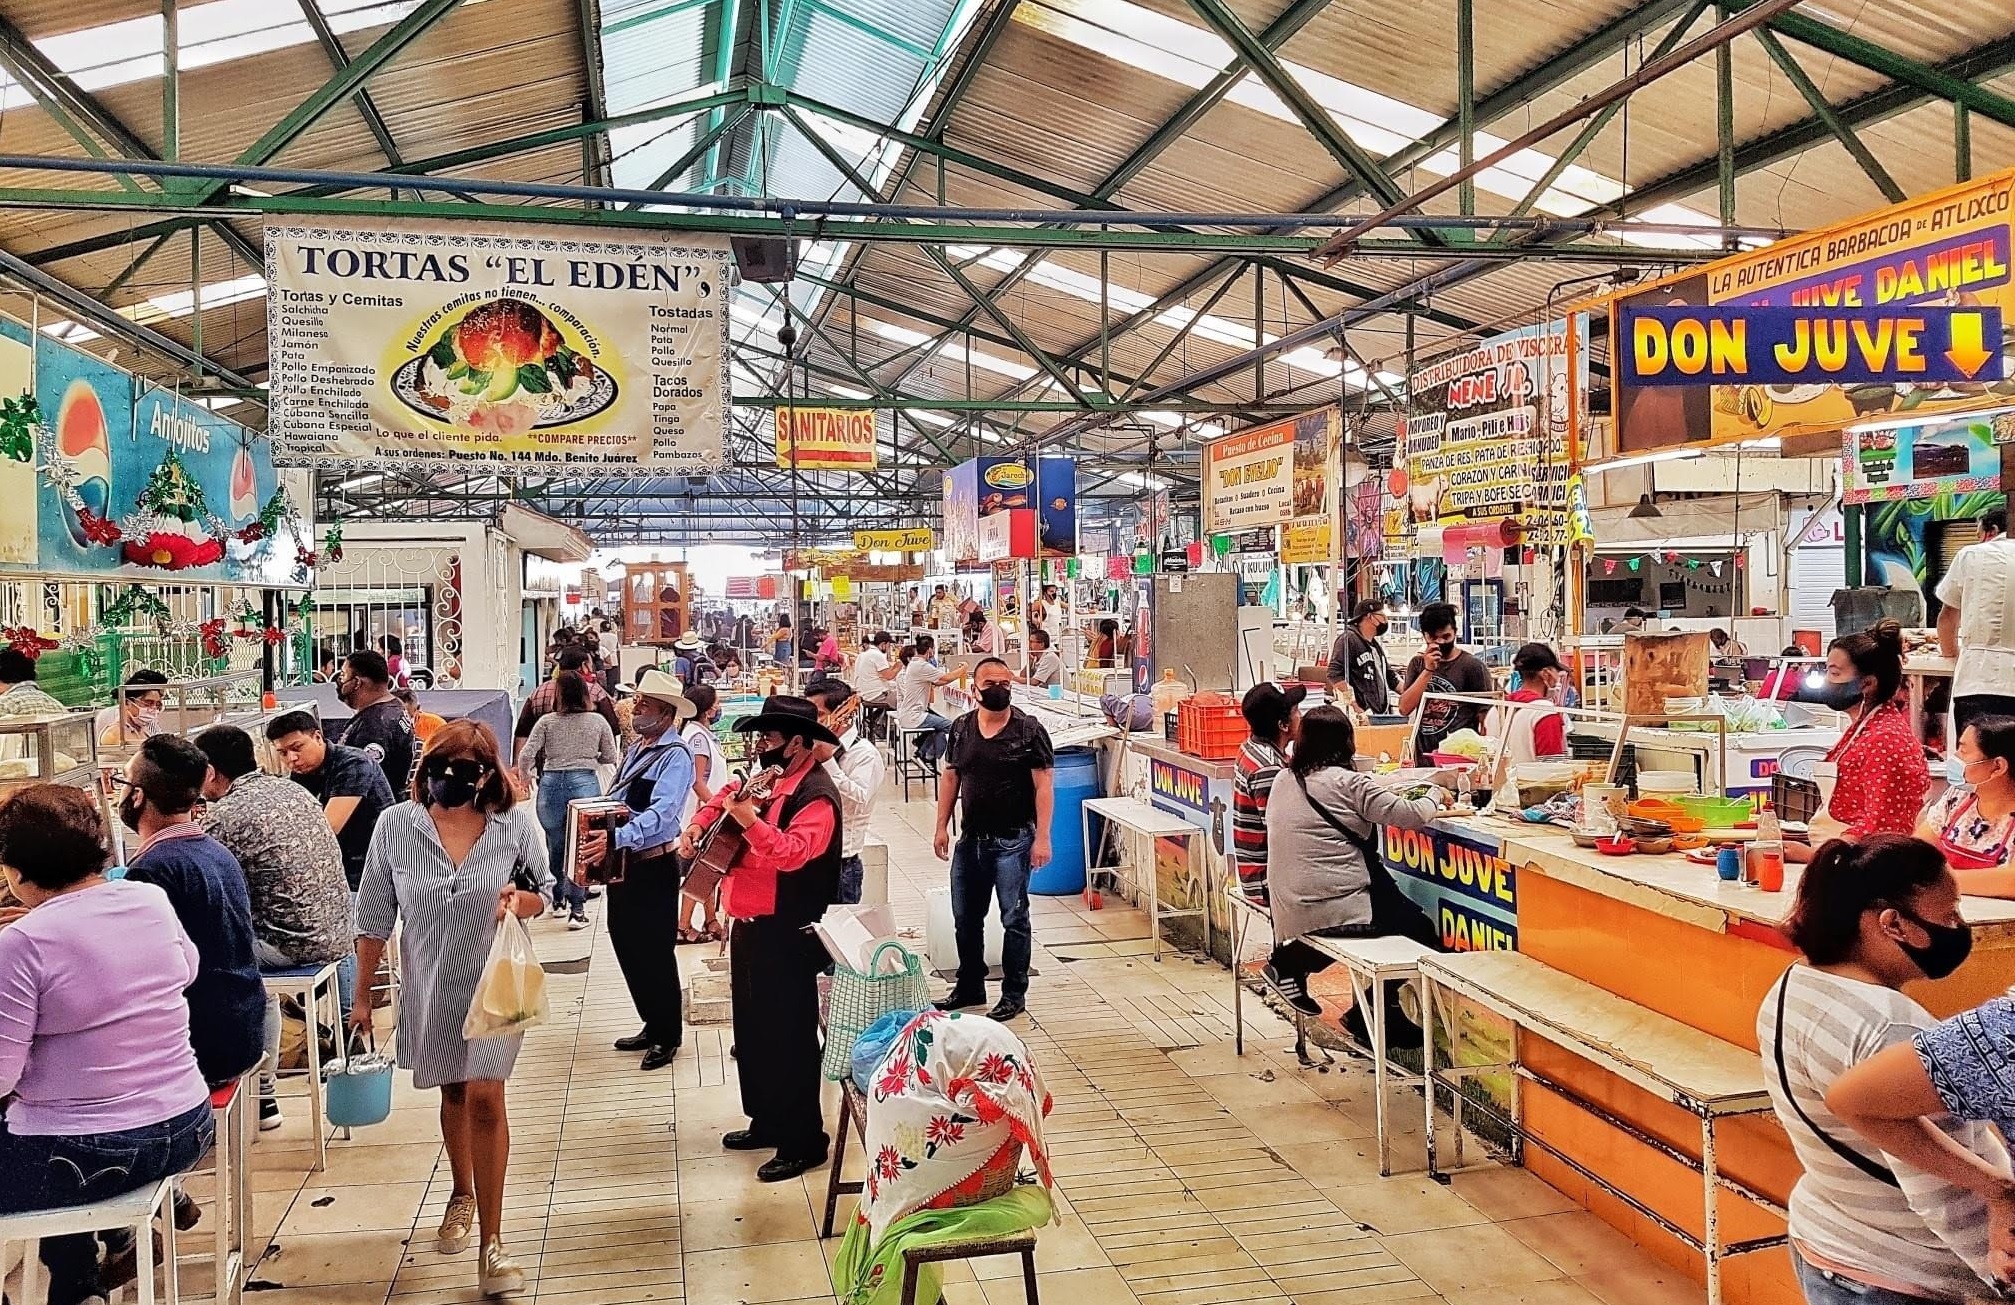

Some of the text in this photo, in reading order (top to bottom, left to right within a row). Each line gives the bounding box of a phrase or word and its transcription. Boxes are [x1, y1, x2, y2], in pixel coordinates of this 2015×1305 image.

[1713, 190, 2009, 294] LA AUTENTICA BARBACOA DE ATLIXCO
[297, 246, 470, 283] TORTAS
[1876, 239, 2008, 305] DANIEL
[281, 289, 403, 307] Tortas y Cemitas
[282, 305, 329, 315] Salchicha
[648, 305, 713, 318] Tostadas
[282, 316, 324, 326] Quesillo
[405, 311, 442, 353] Nuestras
[442, 291, 481, 313] cemitas
[484, 288, 498, 299] no
[281, 328, 329, 338] Milanesa
[650, 324, 688, 334] Normal
[281, 340, 319, 349] Jamón
[651, 335, 673, 344] Pata
[651, 346, 675, 355] Pollo
[1634, 318, 1926, 376] DON JUVE
[282, 351, 305, 360] Pata
[651, 357, 692, 367] Quesillo
[281, 362, 376, 377] Pollo Empanizado
[1413, 351, 1493, 393] DISTRIBUIDORA
[1497, 343, 1513, 363] DE
[282, 373, 375, 386] Pollo Deshebrado
[653, 374, 688, 386] Tacos
[282, 385, 362, 397] Pollo Enchilado
[653, 386, 703, 398] Dorados
[1449, 373, 1497, 407] NENE
[283, 396, 369, 409] Carne Enchilada
[652, 403, 676, 413] Papa
[283, 408, 369, 420] Cubana Sencilla
[653, 414, 680, 424] Tinga
[150, 400, 210, 454] Antojitos
[283, 420, 372, 432] Cubana Especial
[653, 426, 685, 435] Queso
[778, 411, 873, 444] SANITARIOS
[1482, 418, 1497, 437] Pili
[1499, 420, 1505, 433] e
[284, 432, 339, 441] Hawaiana
[376, 428, 503, 445] Lo que el cliente pida.
[653, 438, 677, 447] Pollo
[286, 443, 326, 453] Tropical
[1222, 432, 1284, 457] Puesto de Cecina
[374, 446, 638, 464] A sus ordenes: Puesto No. 144 Mdo. Benito Juárez
[653, 450, 703, 459] Pambazos
[1422, 456, 1444, 471] PANZA
[1446, 454, 1455, 467] DE
[1475, 447, 1495, 462] PATA
[1497, 445, 1507, 459] DE
[1451, 466, 1489, 485] CORAZÓN
[1490, 467, 1496, 479] Y
[1451, 491, 1475, 505] TRIPA
[1476, 489, 1482, 502] Y
[1484, 487, 1506, 502] BOFE
[1278, 499, 1292, 507] Local
[1472, 505, 1514, 516] A SUS ORDENES
[857, 532, 930, 550] Don Juve
[1154, 762, 1203, 807] DON JUVE
[1387, 824, 1513, 904] DON JUVE
